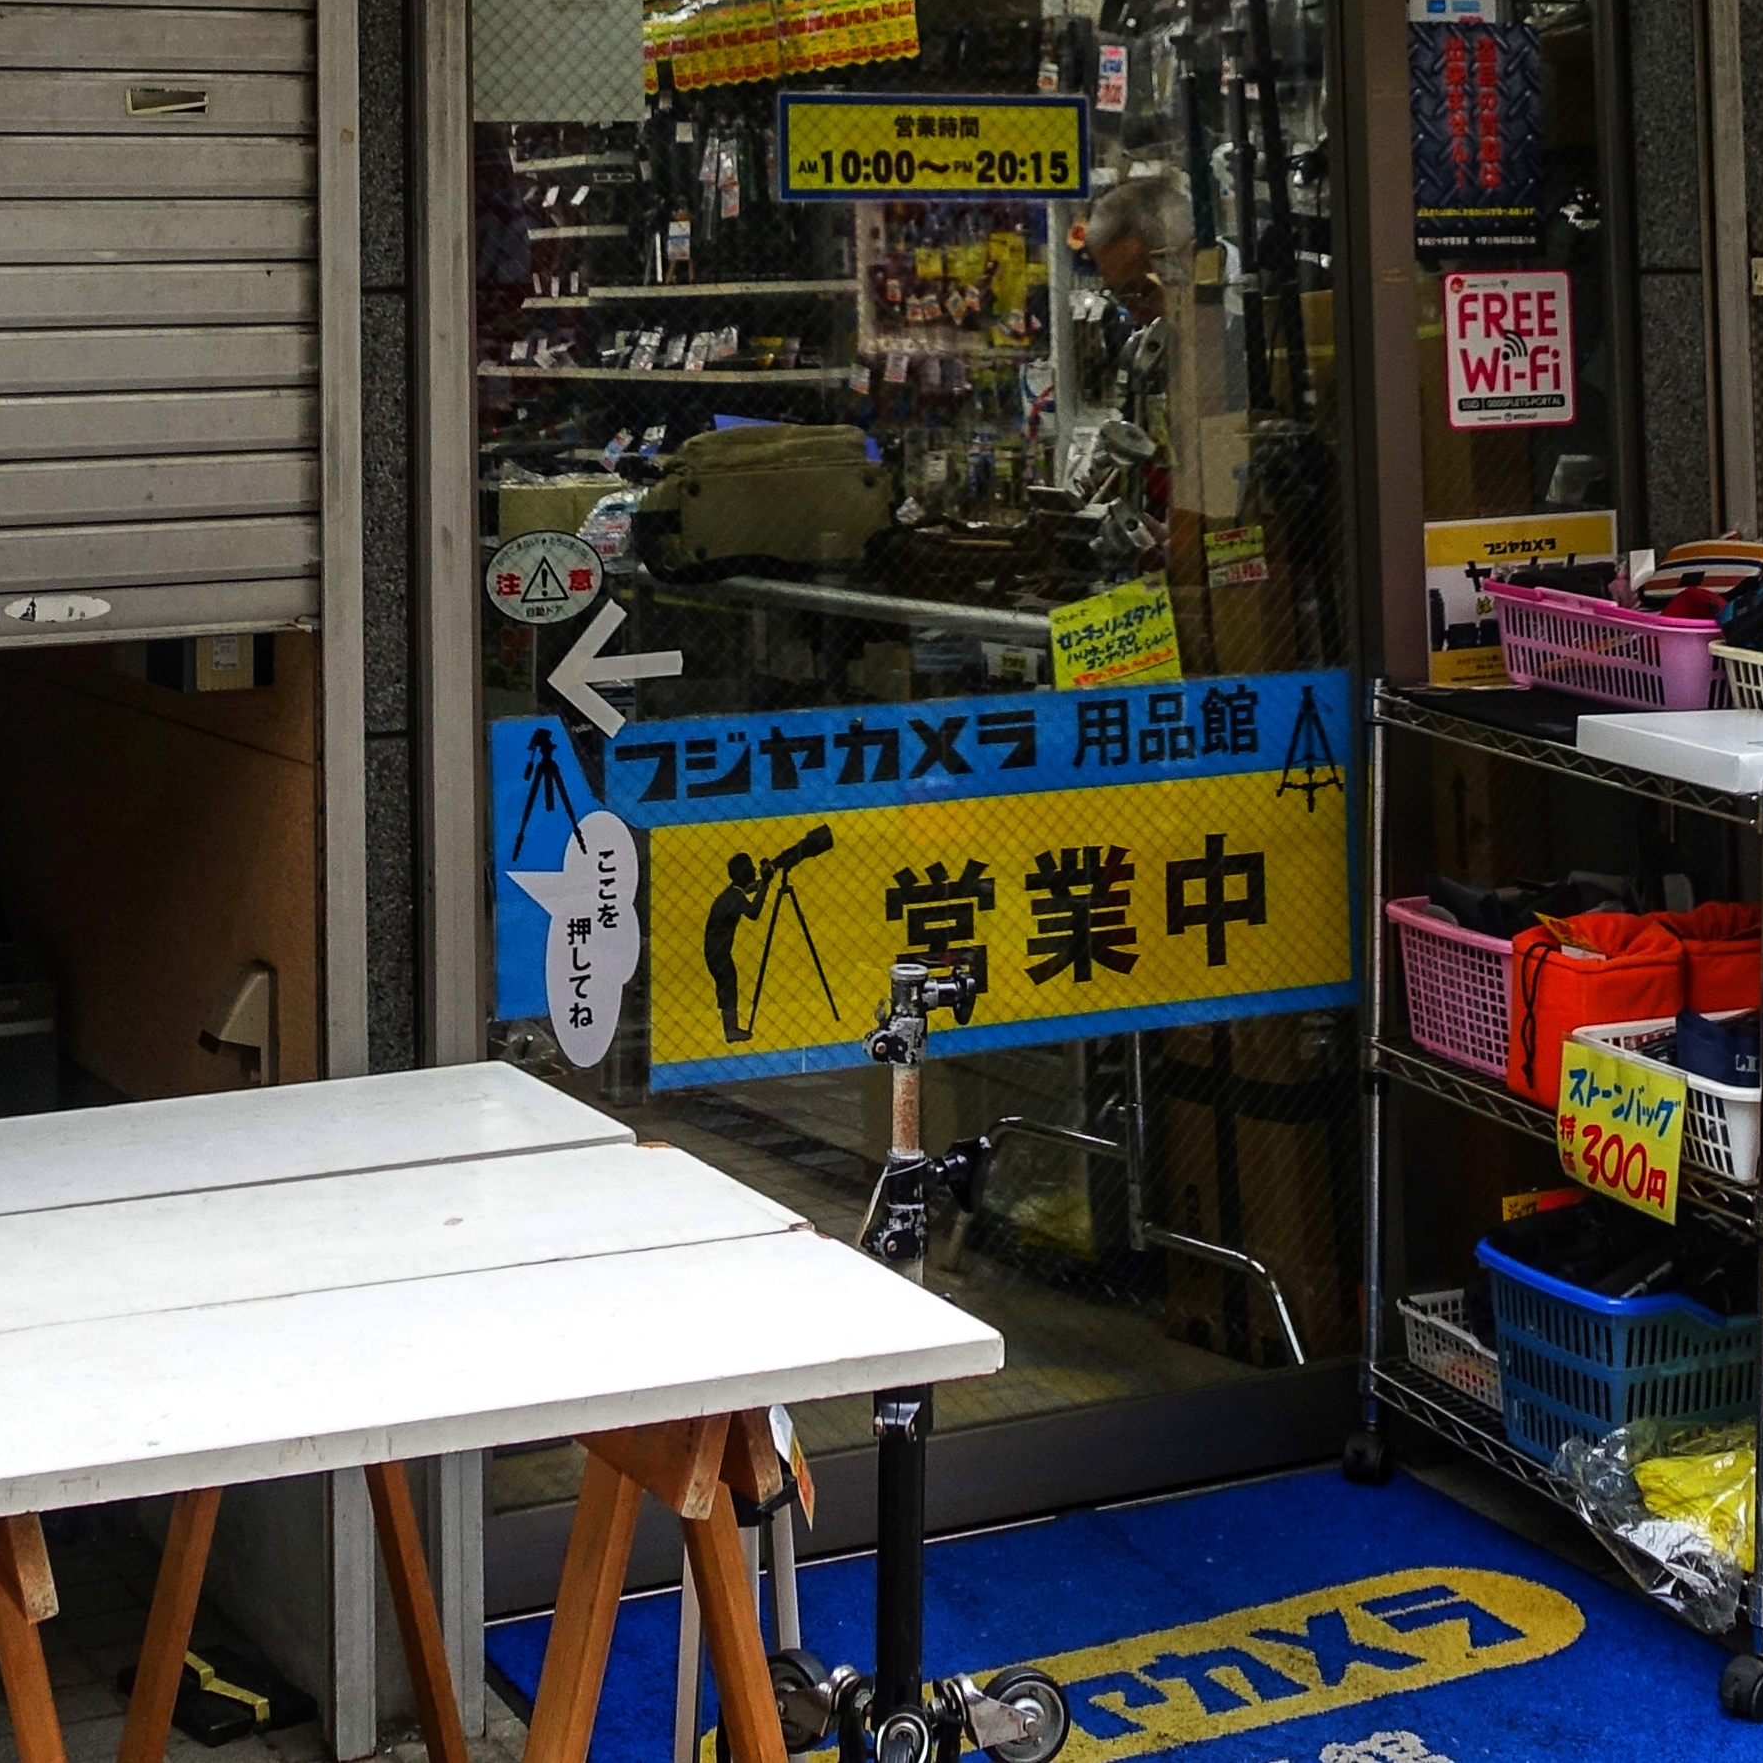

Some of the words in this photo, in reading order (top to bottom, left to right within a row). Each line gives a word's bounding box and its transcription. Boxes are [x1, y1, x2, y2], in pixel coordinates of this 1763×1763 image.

[894, 114, 980, 139] 営業時間
[1456, 290, 1558, 339] FREE
[1459, 344, 1562, 394] Wi-Fi
[1483, 538, 1557, 555] フジヤカメラ
[615, 710, 1037, 803] フジヤカメラ
[1073, 684, 1260, 769] 用品館
[597, 849, 619, 930] ここを
[885, 834, 1267, 994] 営業中
[567, 918, 594, 1030] 押してね
